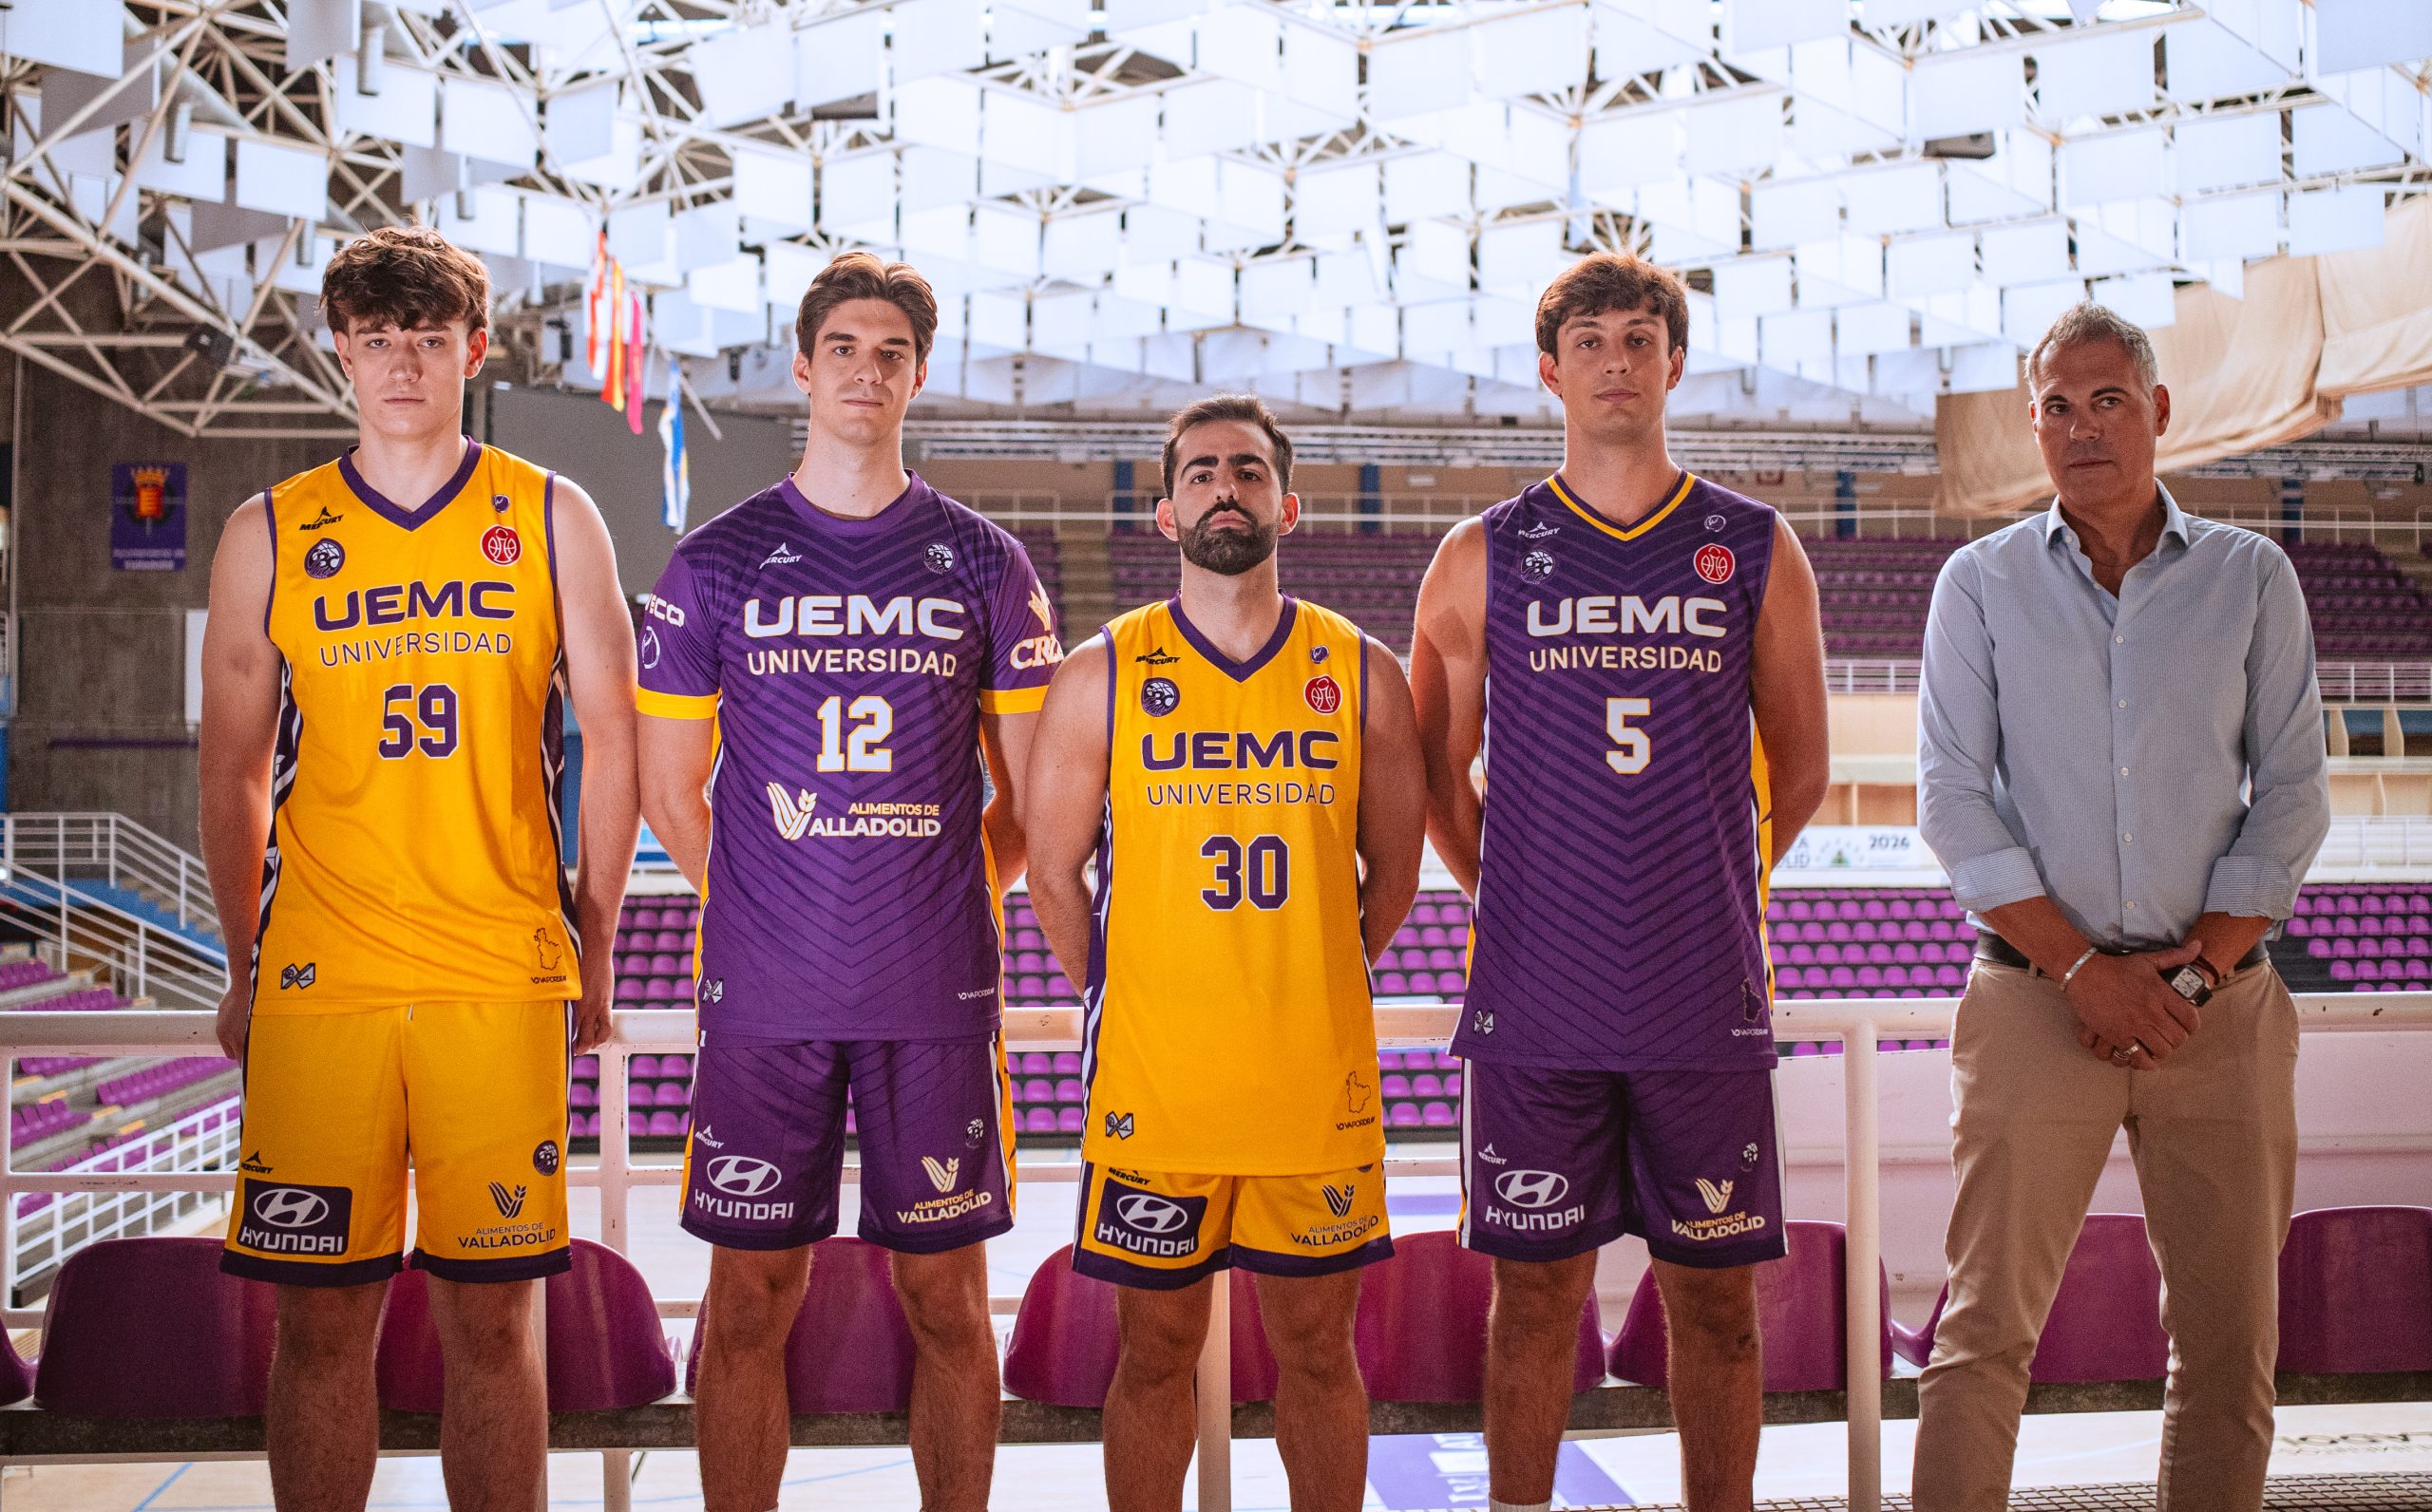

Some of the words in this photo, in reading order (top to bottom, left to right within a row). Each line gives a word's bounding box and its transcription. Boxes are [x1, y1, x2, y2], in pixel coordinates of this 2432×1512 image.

[298, 514, 344, 531] MERCURY
[1517, 527, 1561, 539] MERCURY
[313, 579, 517, 633] UEMC
[645, 593, 685, 628] ECO
[744, 595, 965, 641] UEMC
[1526, 595, 1728, 638] UEMC
[319, 630, 513, 669] UNIVERSIDAD
[747, 647, 958, 678] UNIVERSIDAD
[1135, 655, 1182, 665] MERCURY
[1529, 646, 1723, 673] UNIVERSIDAD
[378, 683, 460, 760] 59
[816, 695, 893, 772] 12
[1606, 697, 1651, 774] 5
[1141, 730, 1340, 771] UEMC
[1147, 782, 1336, 806] UNIVERSIDAD
[847, 803, 922, 816] ALIMENTOS
[923, 804, 940, 816] DE
[1868, 834, 1910, 851] 2026
[1200, 834, 1290, 911] 30
[1108, 1166, 1151, 1185] MERCURY
[694, 1188, 794, 1220] HYUNDAI
[896, 1191, 993, 1223] VALLADOLID
[914, 1194, 964, 1211] ALIMENTOS
[964, 1188, 975, 1200] DE
[476, 1224, 530, 1235] ALIMENTOS
[532, 1221, 544, 1231] DE
[1291, 1215, 1379, 1246] VALLADOLID
[1308, 1219, 1358, 1234] ALIMENTOS
[1485, 1204, 1586, 1231] HYUNDAI
[1672, 1216, 1766, 1241] VALLADOLID
[1685, 1215, 1734, 1230] ALIMENTOS
[1734, 1210, 1746, 1221] DE
[239, 1226, 343, 1252] HYUNDAI
[458, 1228, 556, 1248] VALLADOLID
[1097, 1222, 1195, 1256] HYUNDAI
